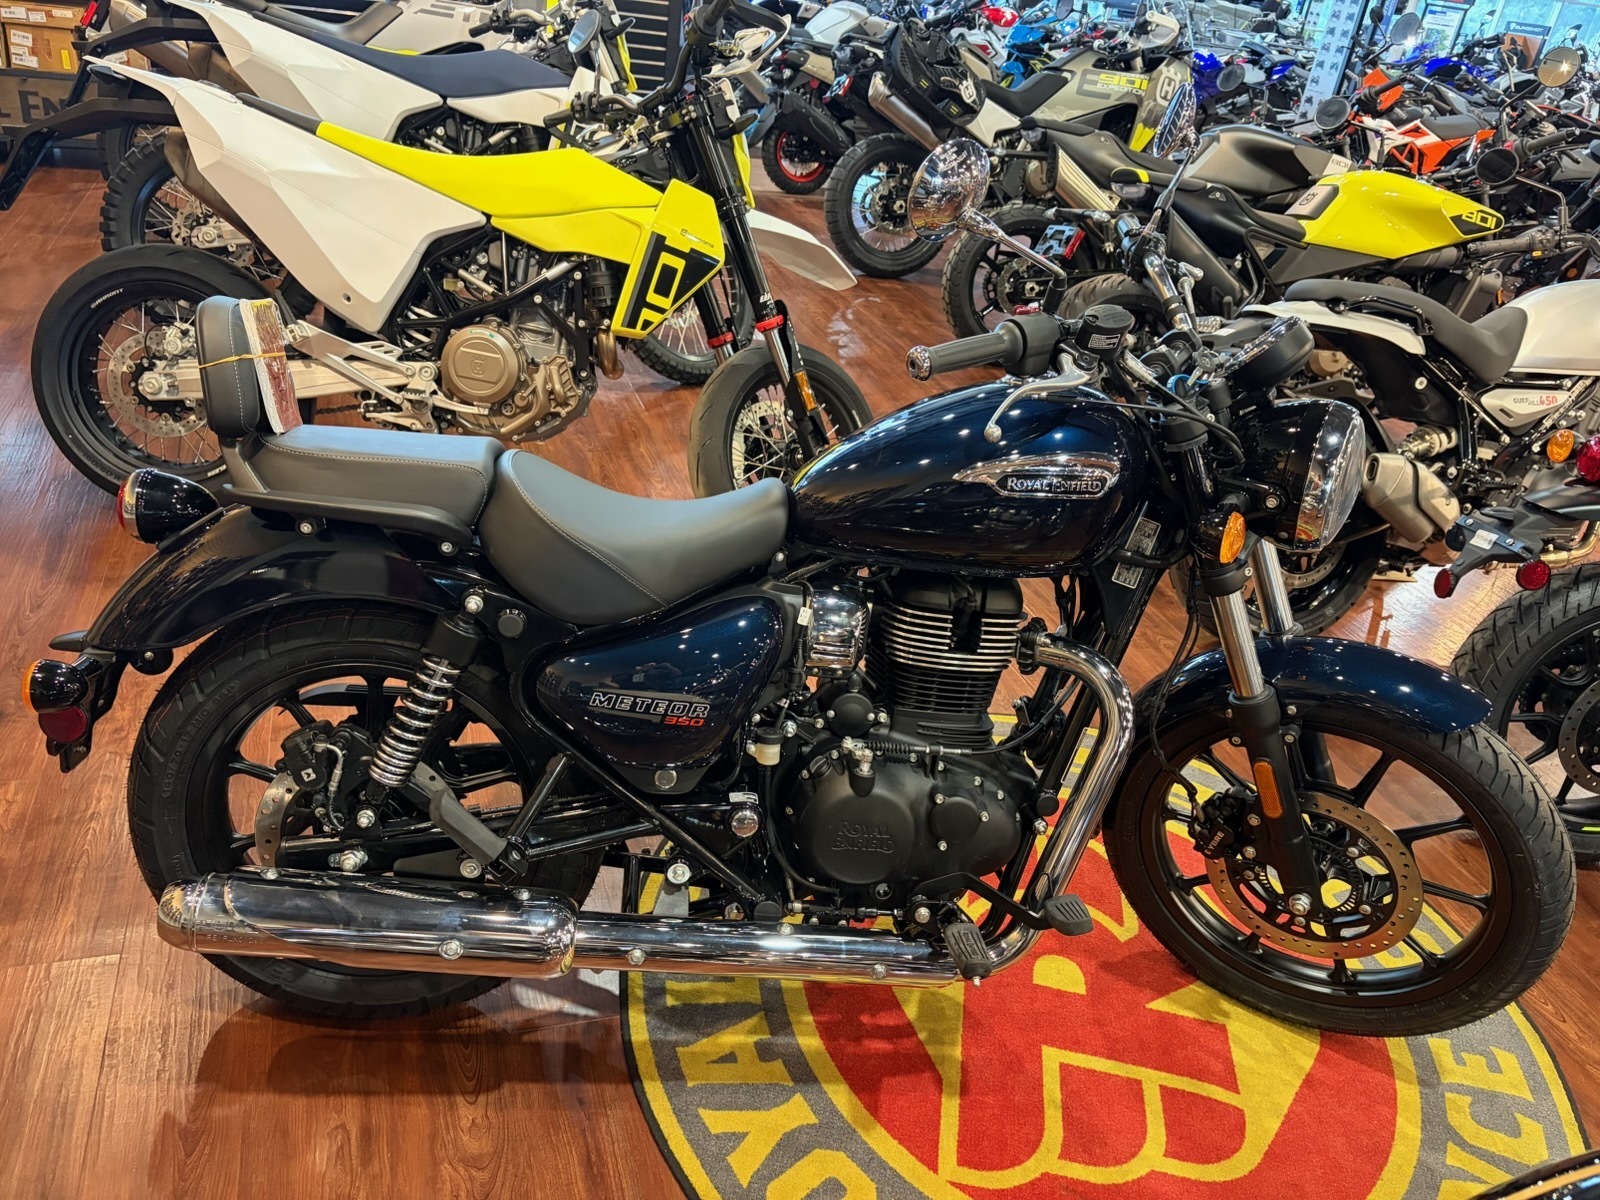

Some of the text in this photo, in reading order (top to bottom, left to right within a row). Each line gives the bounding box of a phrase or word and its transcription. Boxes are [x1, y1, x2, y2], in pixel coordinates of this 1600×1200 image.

[1097, 83, 1145, 96] EXPEDITION
[1099, 74, 1149, 91] 901
[1462, 211, 1496, 229] 801
[1007, 477, 1102, 492] ROYAL ENFIELD
[589, 692, 710, 718] METEOR
[664, 716, 705, 726] 350
[838, 821, 891, 837] ROYAL
[830, 838, 895, 854] ENFIELD
